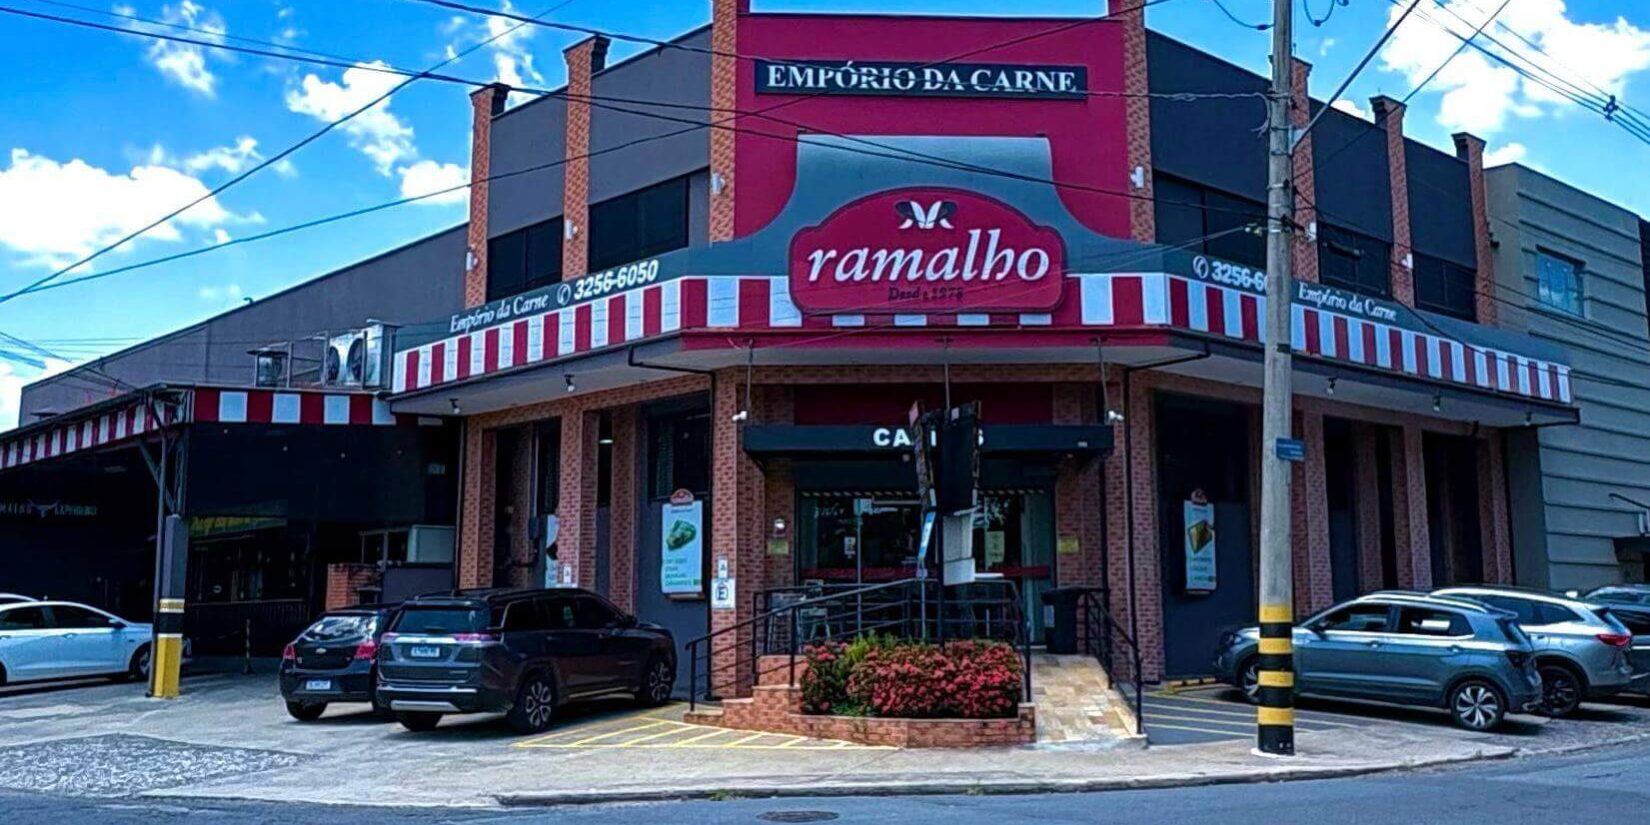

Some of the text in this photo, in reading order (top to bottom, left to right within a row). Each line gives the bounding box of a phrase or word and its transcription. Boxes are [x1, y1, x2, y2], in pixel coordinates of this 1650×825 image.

[766, 60, 1077, 93] EMPÓRIO DA CARNE
[807, 228, 1050, 281] ramalho
[450, 259, 659, 334] Empório da Carne 3256-6050
[1349, 295, 1364, 314] da
[1364, 301, 1398, 323] Carne
